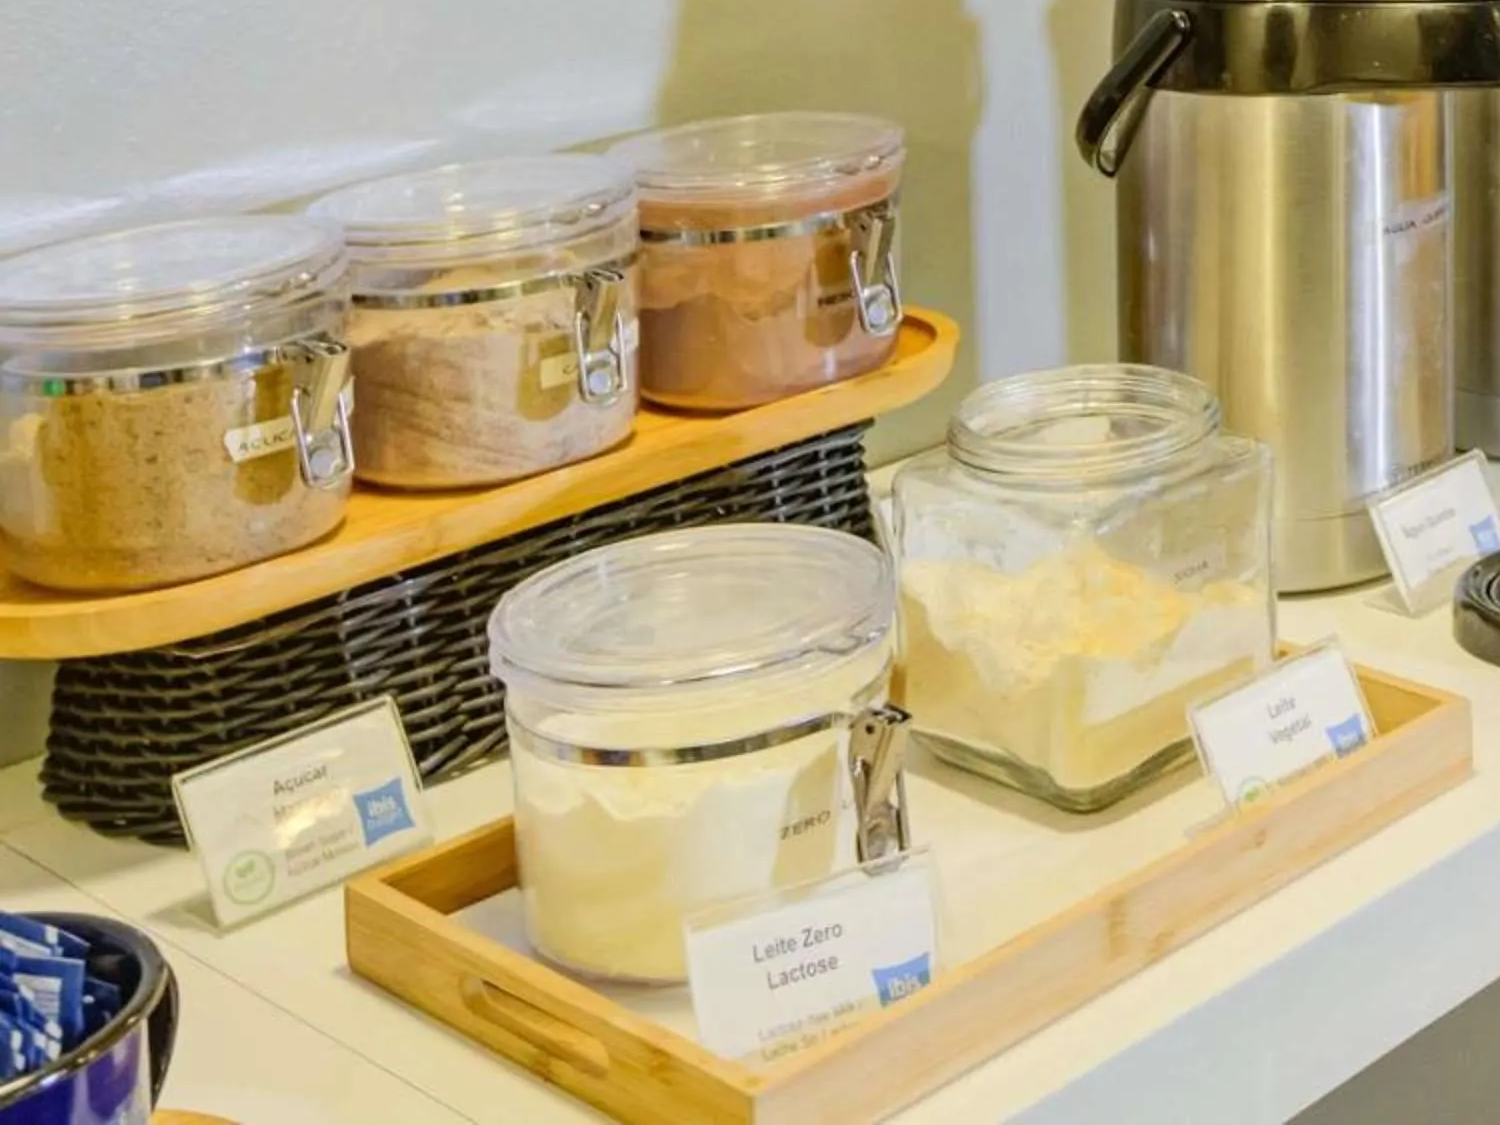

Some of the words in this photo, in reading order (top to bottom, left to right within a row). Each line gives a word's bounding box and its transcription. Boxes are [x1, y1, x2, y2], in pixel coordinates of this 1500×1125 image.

[780, 809, 832, 841] ZERO
[752, 937, 798, 964] Leite
[801, 922, 844, 950] Zero
[766, 953, 840, 991] Lactose
